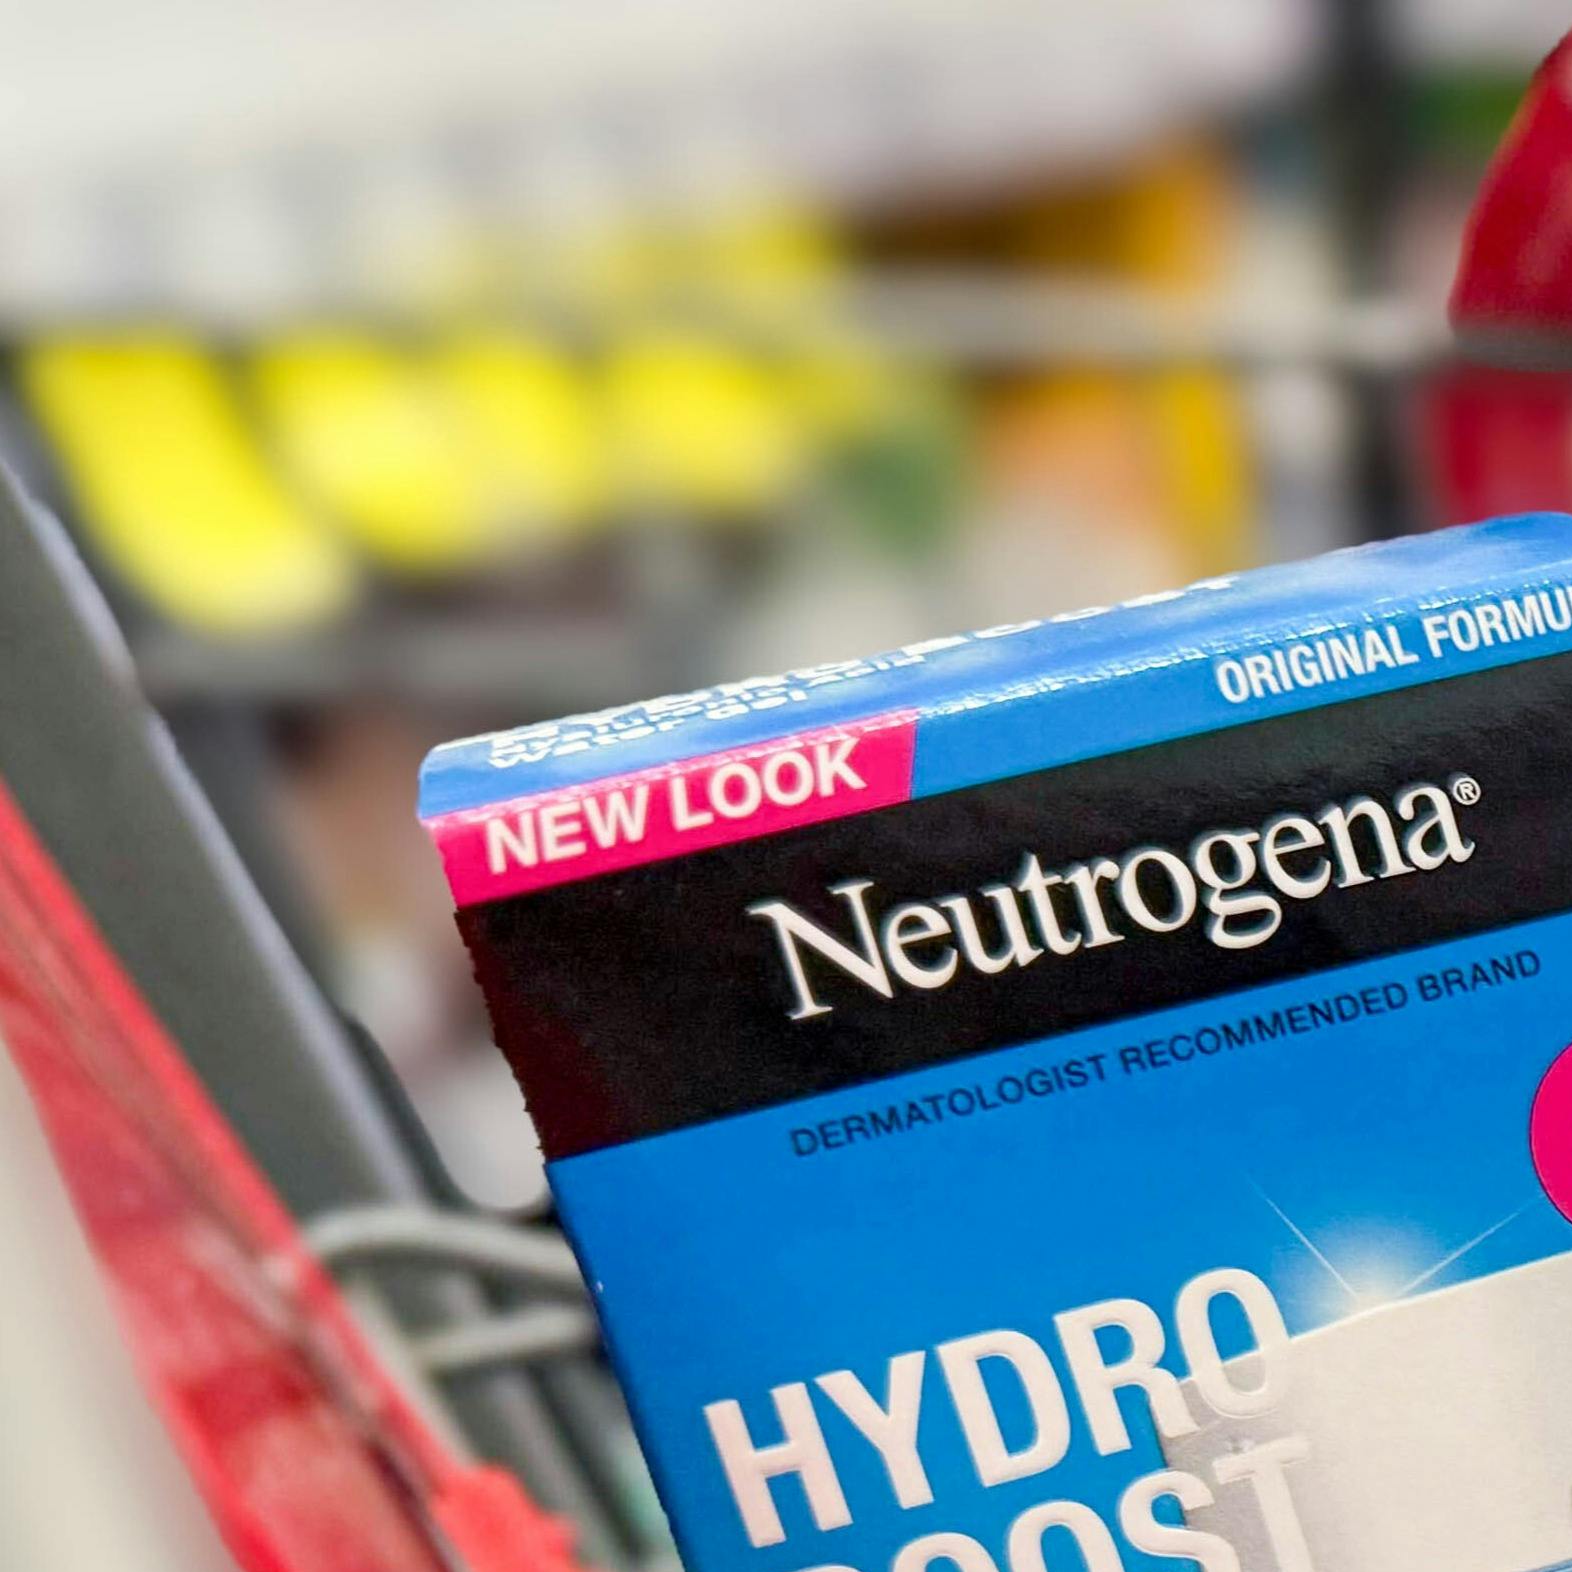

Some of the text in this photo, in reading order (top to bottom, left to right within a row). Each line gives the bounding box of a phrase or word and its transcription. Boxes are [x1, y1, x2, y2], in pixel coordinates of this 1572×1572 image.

[1217, 625, 1419, 703] ORIGINAL
[484, 737, 867, 874] NEW LOOK
[747, 776, 1481, 1020] Neutrogena®
[790, 951, 1541, 1158] DERMATOLOGIST RECOMMENDED BRAND
[703, 1267, 1290, 1547] HYDRO
